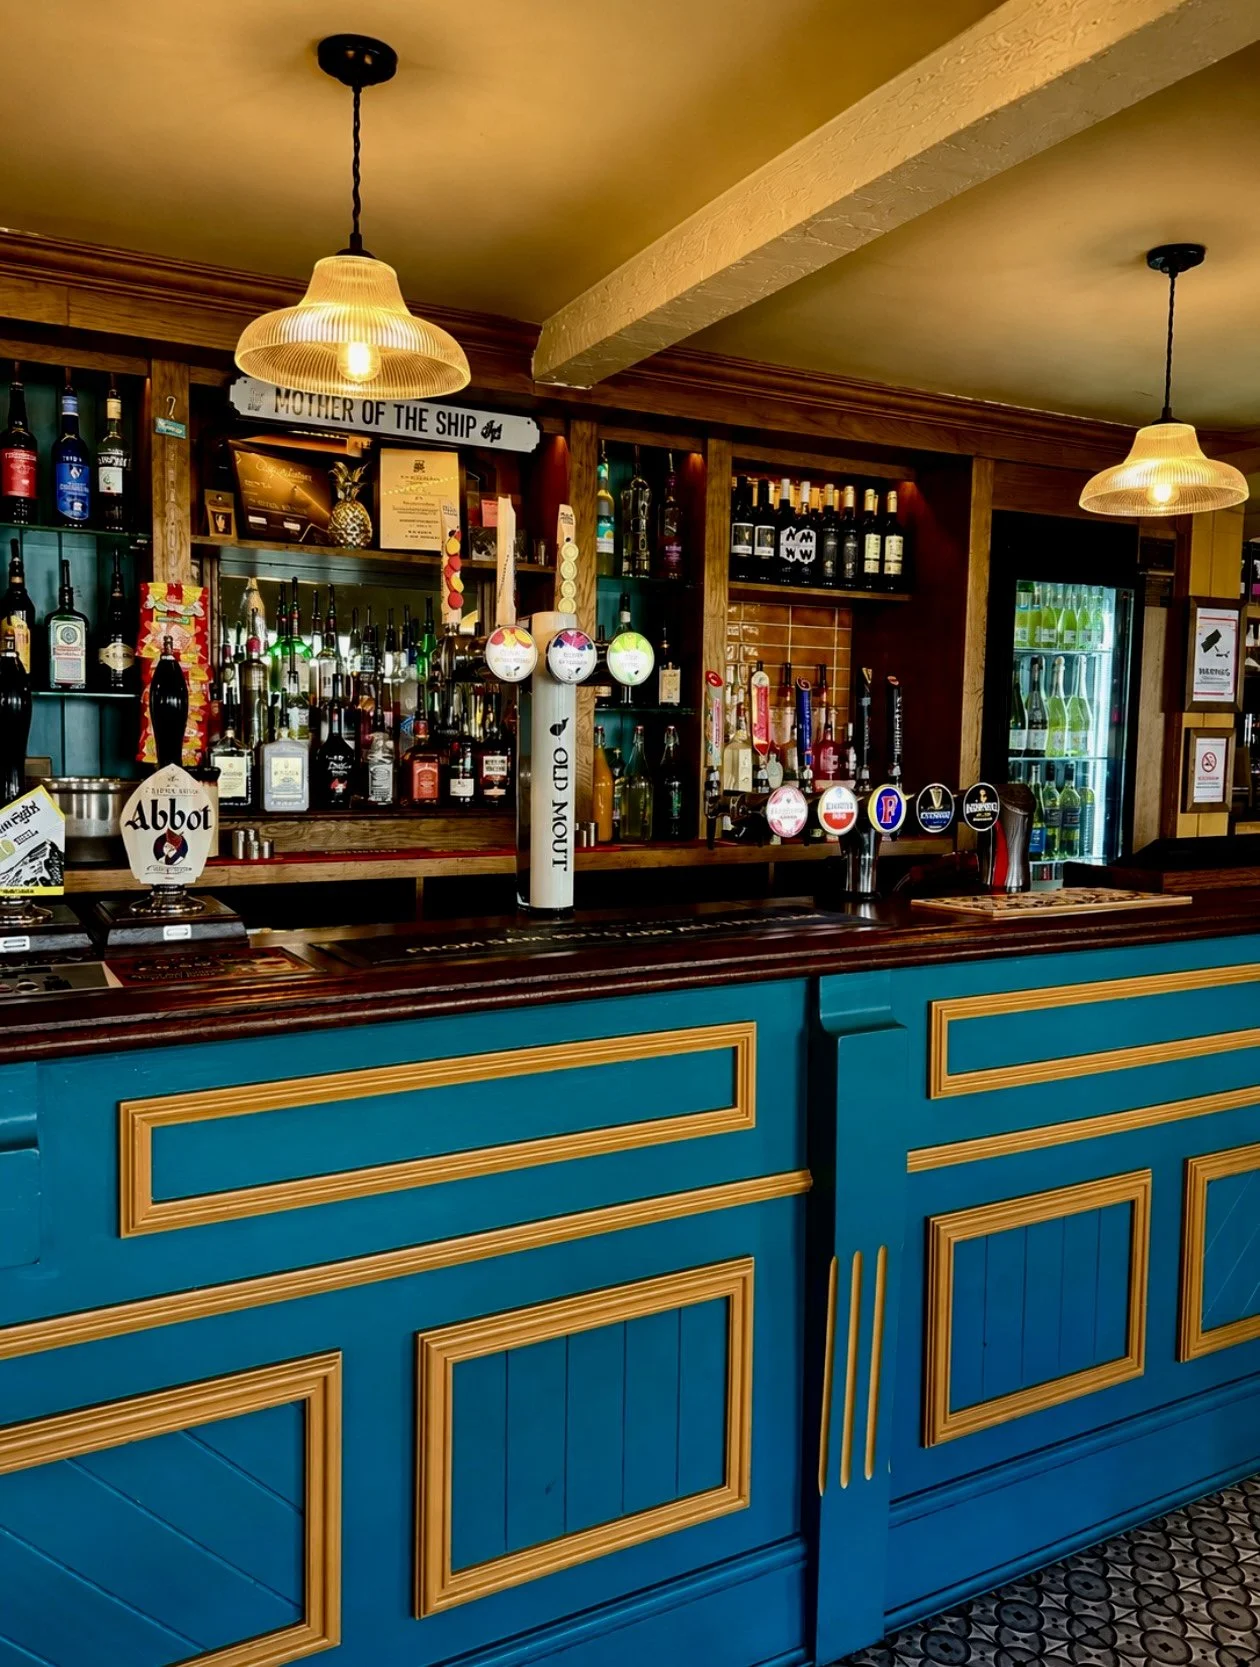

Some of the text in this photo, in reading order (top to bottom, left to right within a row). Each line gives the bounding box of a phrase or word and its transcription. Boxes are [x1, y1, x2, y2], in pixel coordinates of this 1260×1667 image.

[274, 387, 477, 438] MOTHER OF THE SHIP
[124, 798, 212, 831] Abbot
[551, 747, 569, 872] OLD MOUT
[881, 795, 899, 824] F
